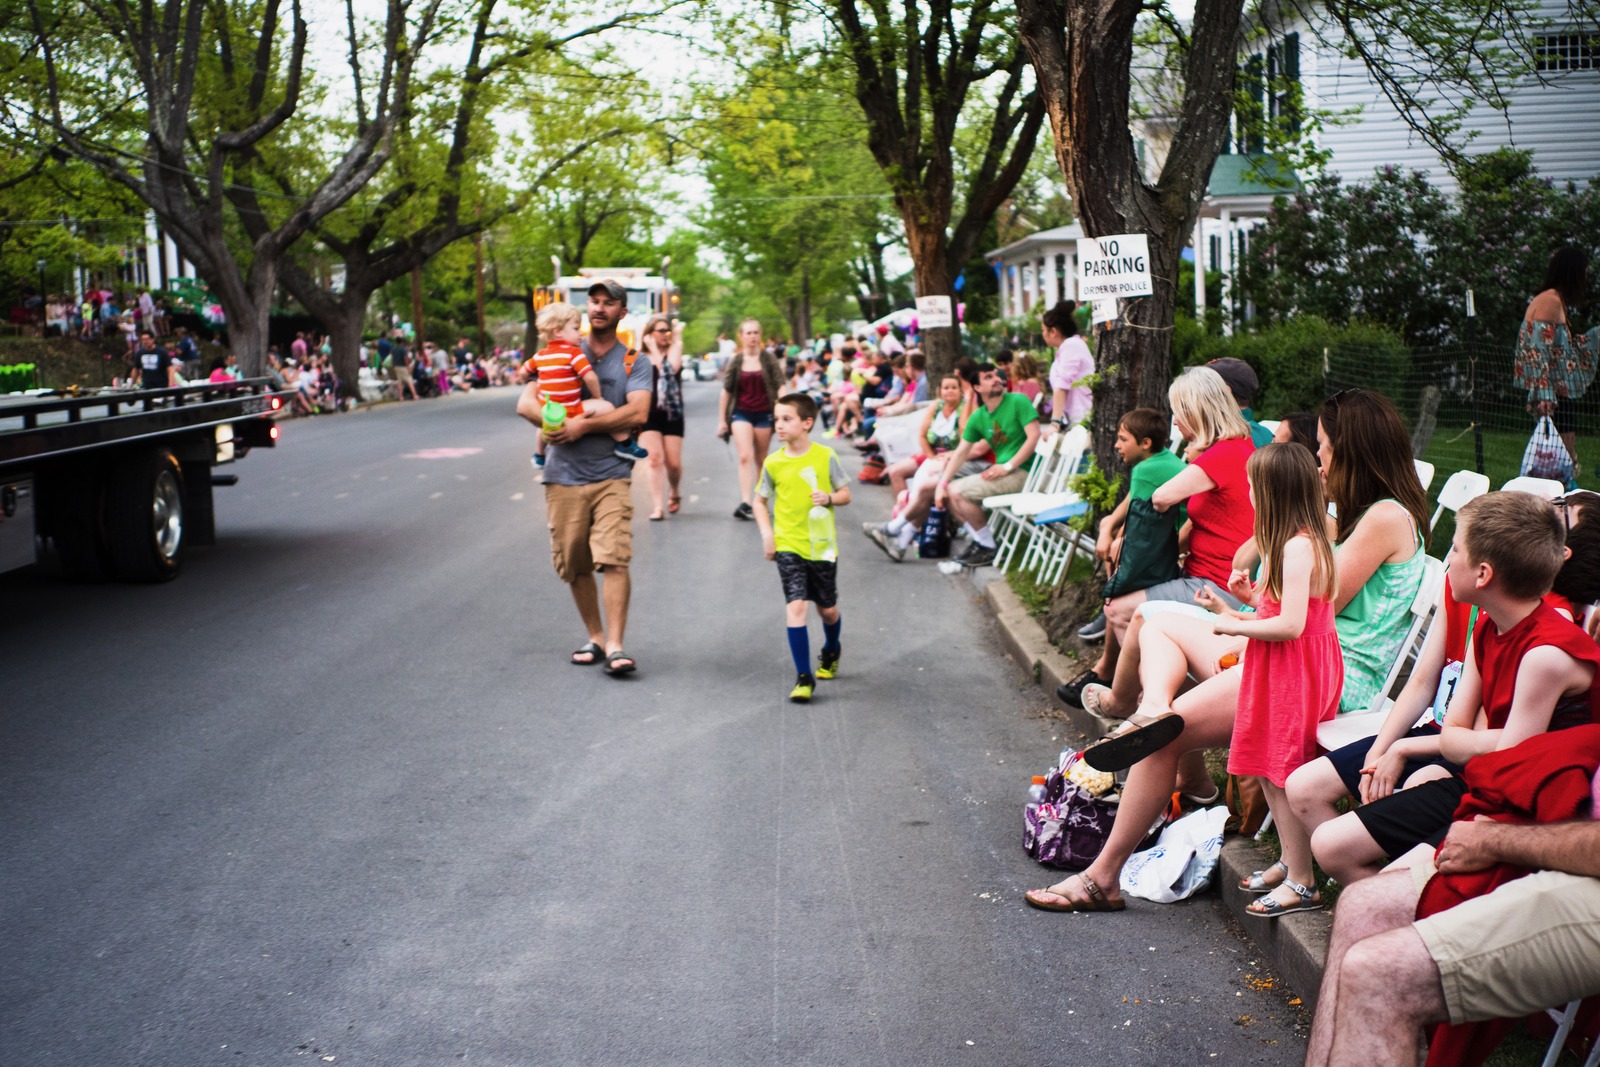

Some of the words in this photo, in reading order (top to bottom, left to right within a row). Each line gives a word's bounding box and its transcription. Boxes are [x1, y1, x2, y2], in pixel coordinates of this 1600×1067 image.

[1099, 240, 1119, 257] NO
[1084, 256, 1145, 277] PARKING
[1084, 285, 1109, 294] ORDER
[1109, 284, 1118, 293] OF
[1120, 281, 1147, 292] POLICE
[927, 298, 937, 306] NO
